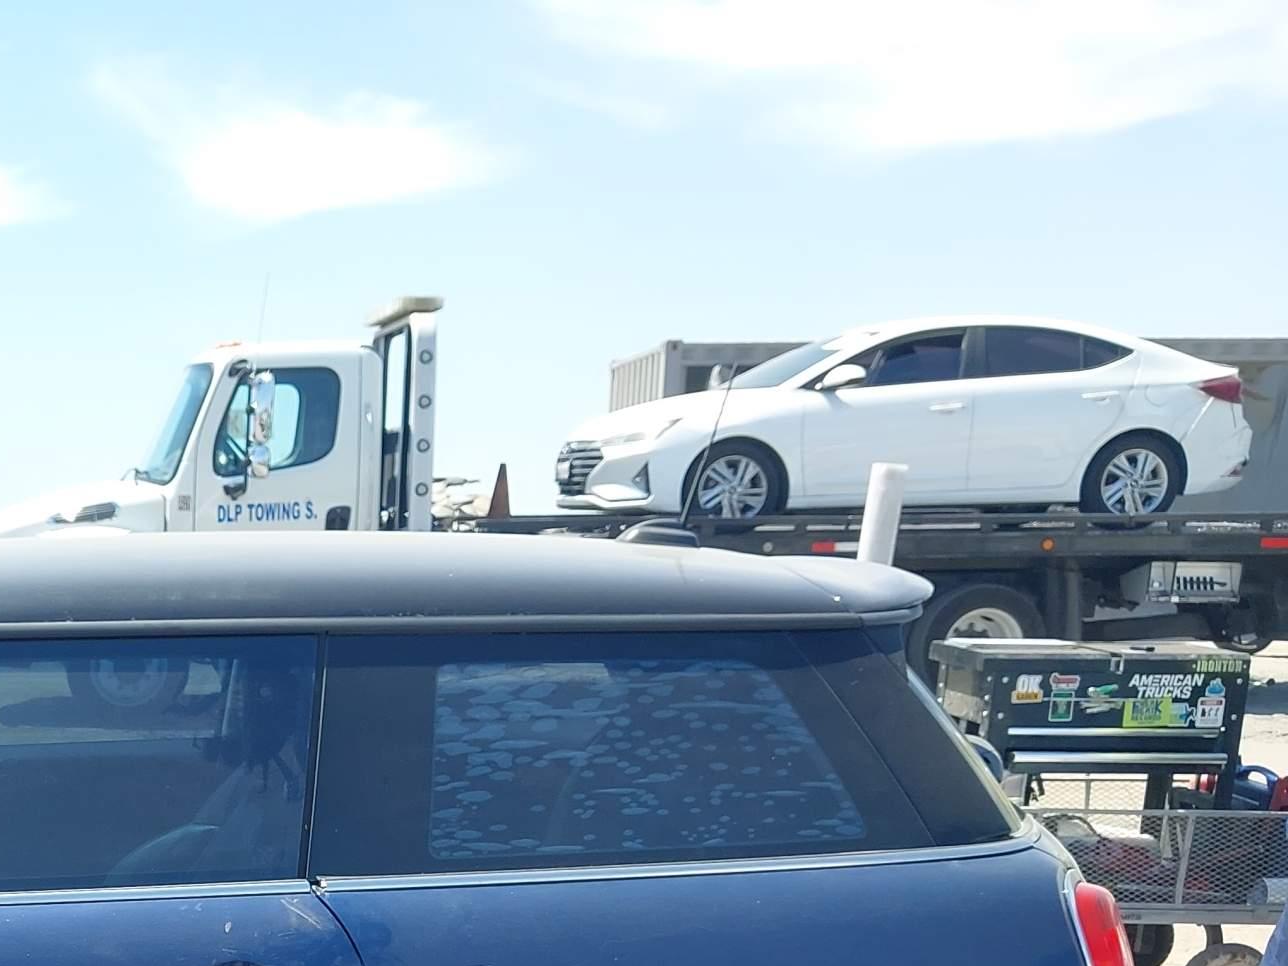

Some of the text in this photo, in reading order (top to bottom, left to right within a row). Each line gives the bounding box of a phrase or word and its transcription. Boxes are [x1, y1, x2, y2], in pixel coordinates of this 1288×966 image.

[217, 504, 242, 523] DLP
[247, 501, 300, 522] TOWING
[1196, 660, 1242, 673] IRONTON
[1129, 673, 1205, 687] AMERICAN
[1137, 685, 1193, 699] TRUCKS
